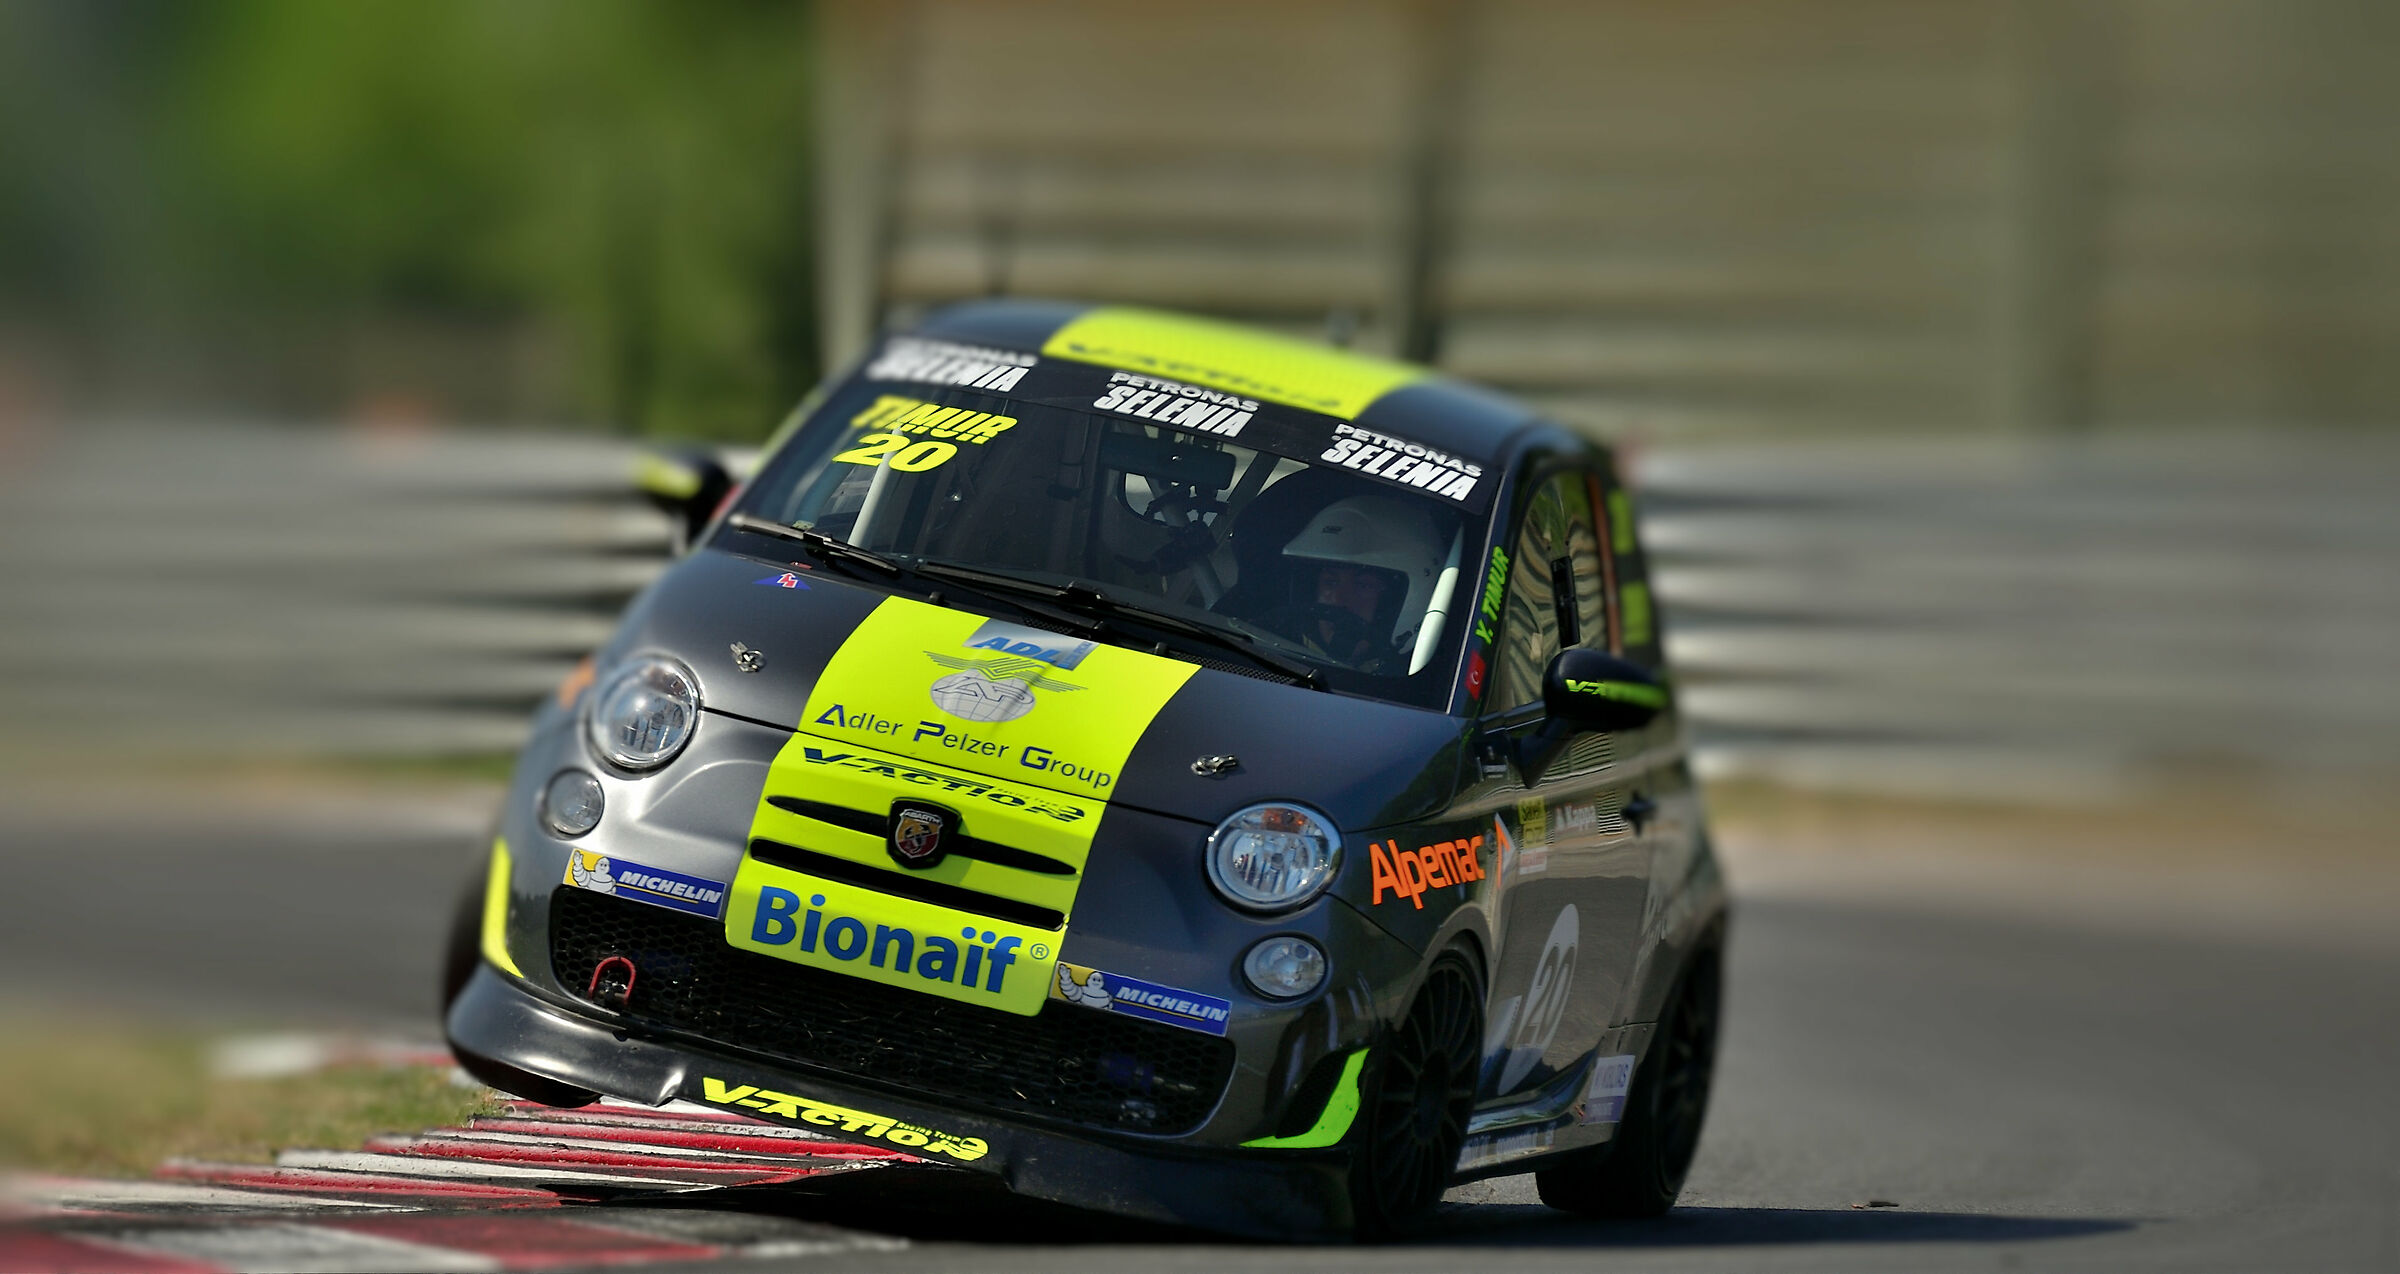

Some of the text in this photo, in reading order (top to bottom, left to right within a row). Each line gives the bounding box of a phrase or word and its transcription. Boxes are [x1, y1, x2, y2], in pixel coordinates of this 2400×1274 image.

[851, 394, 1018, 444] TIMUR
[1093, 385, 1254, 438] SELENIA
[1110, 371, 1260, 414] PETRONAS
[831, 433, 958, 472] 20
[1320, 437, 1478, 501] SELENIA
[1337, 423, 1483, 478] PETRONAS
[1481, 545, 1510, 621] TIMUR
[815, 703, 1112, 790] Adler Pelzer Group
[618, 870, 722, 904] MICHELIN
[1368, 835, 1486, 910] Alpemac
[751, 885, 1023, 994] Bionaïf
[1115, 985, 1229, 1023] MICHELIN
[1512, 943, 1579, 1049] 20
